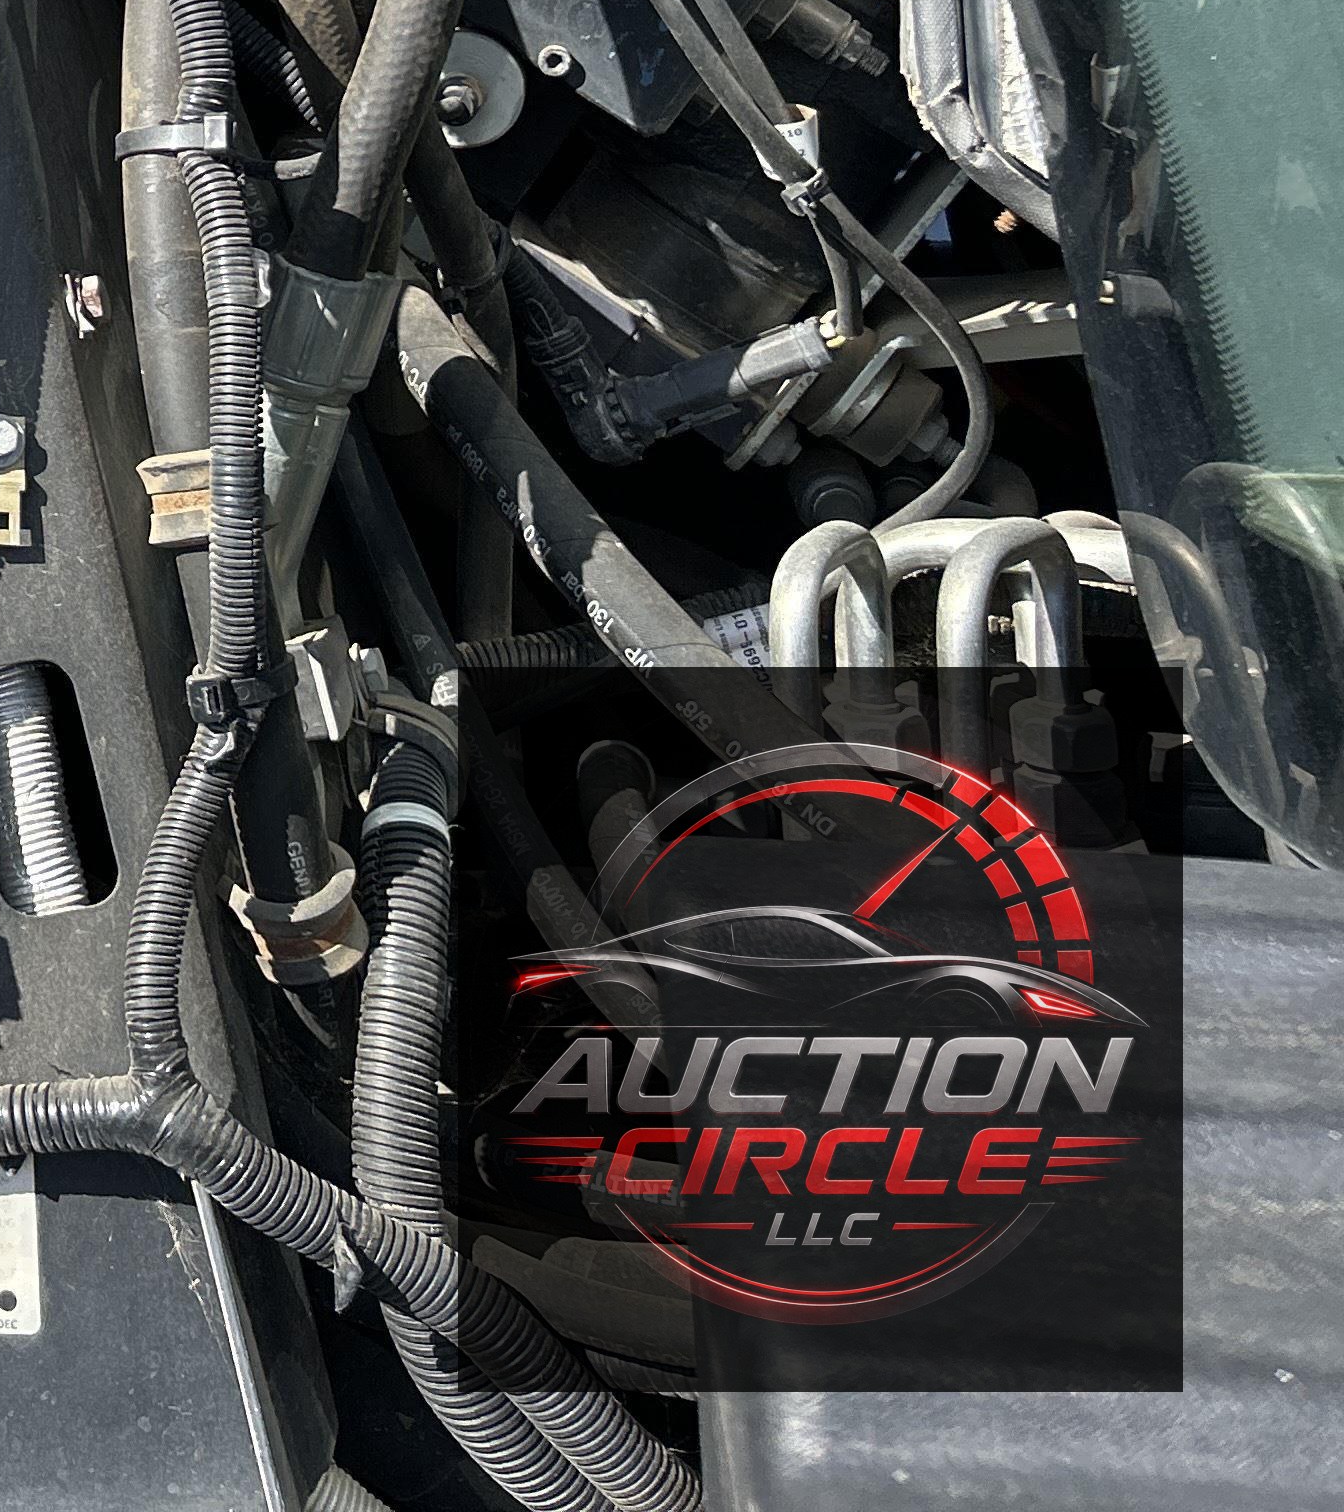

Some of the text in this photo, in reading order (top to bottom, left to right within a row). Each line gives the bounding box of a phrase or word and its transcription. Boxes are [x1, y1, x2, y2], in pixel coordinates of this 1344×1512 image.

[560, 570, 586, 604] bar
[586, 599, 615, 635] 130
[624, 646, 655, 679] WP
[796, 799, 838, 839] DN
